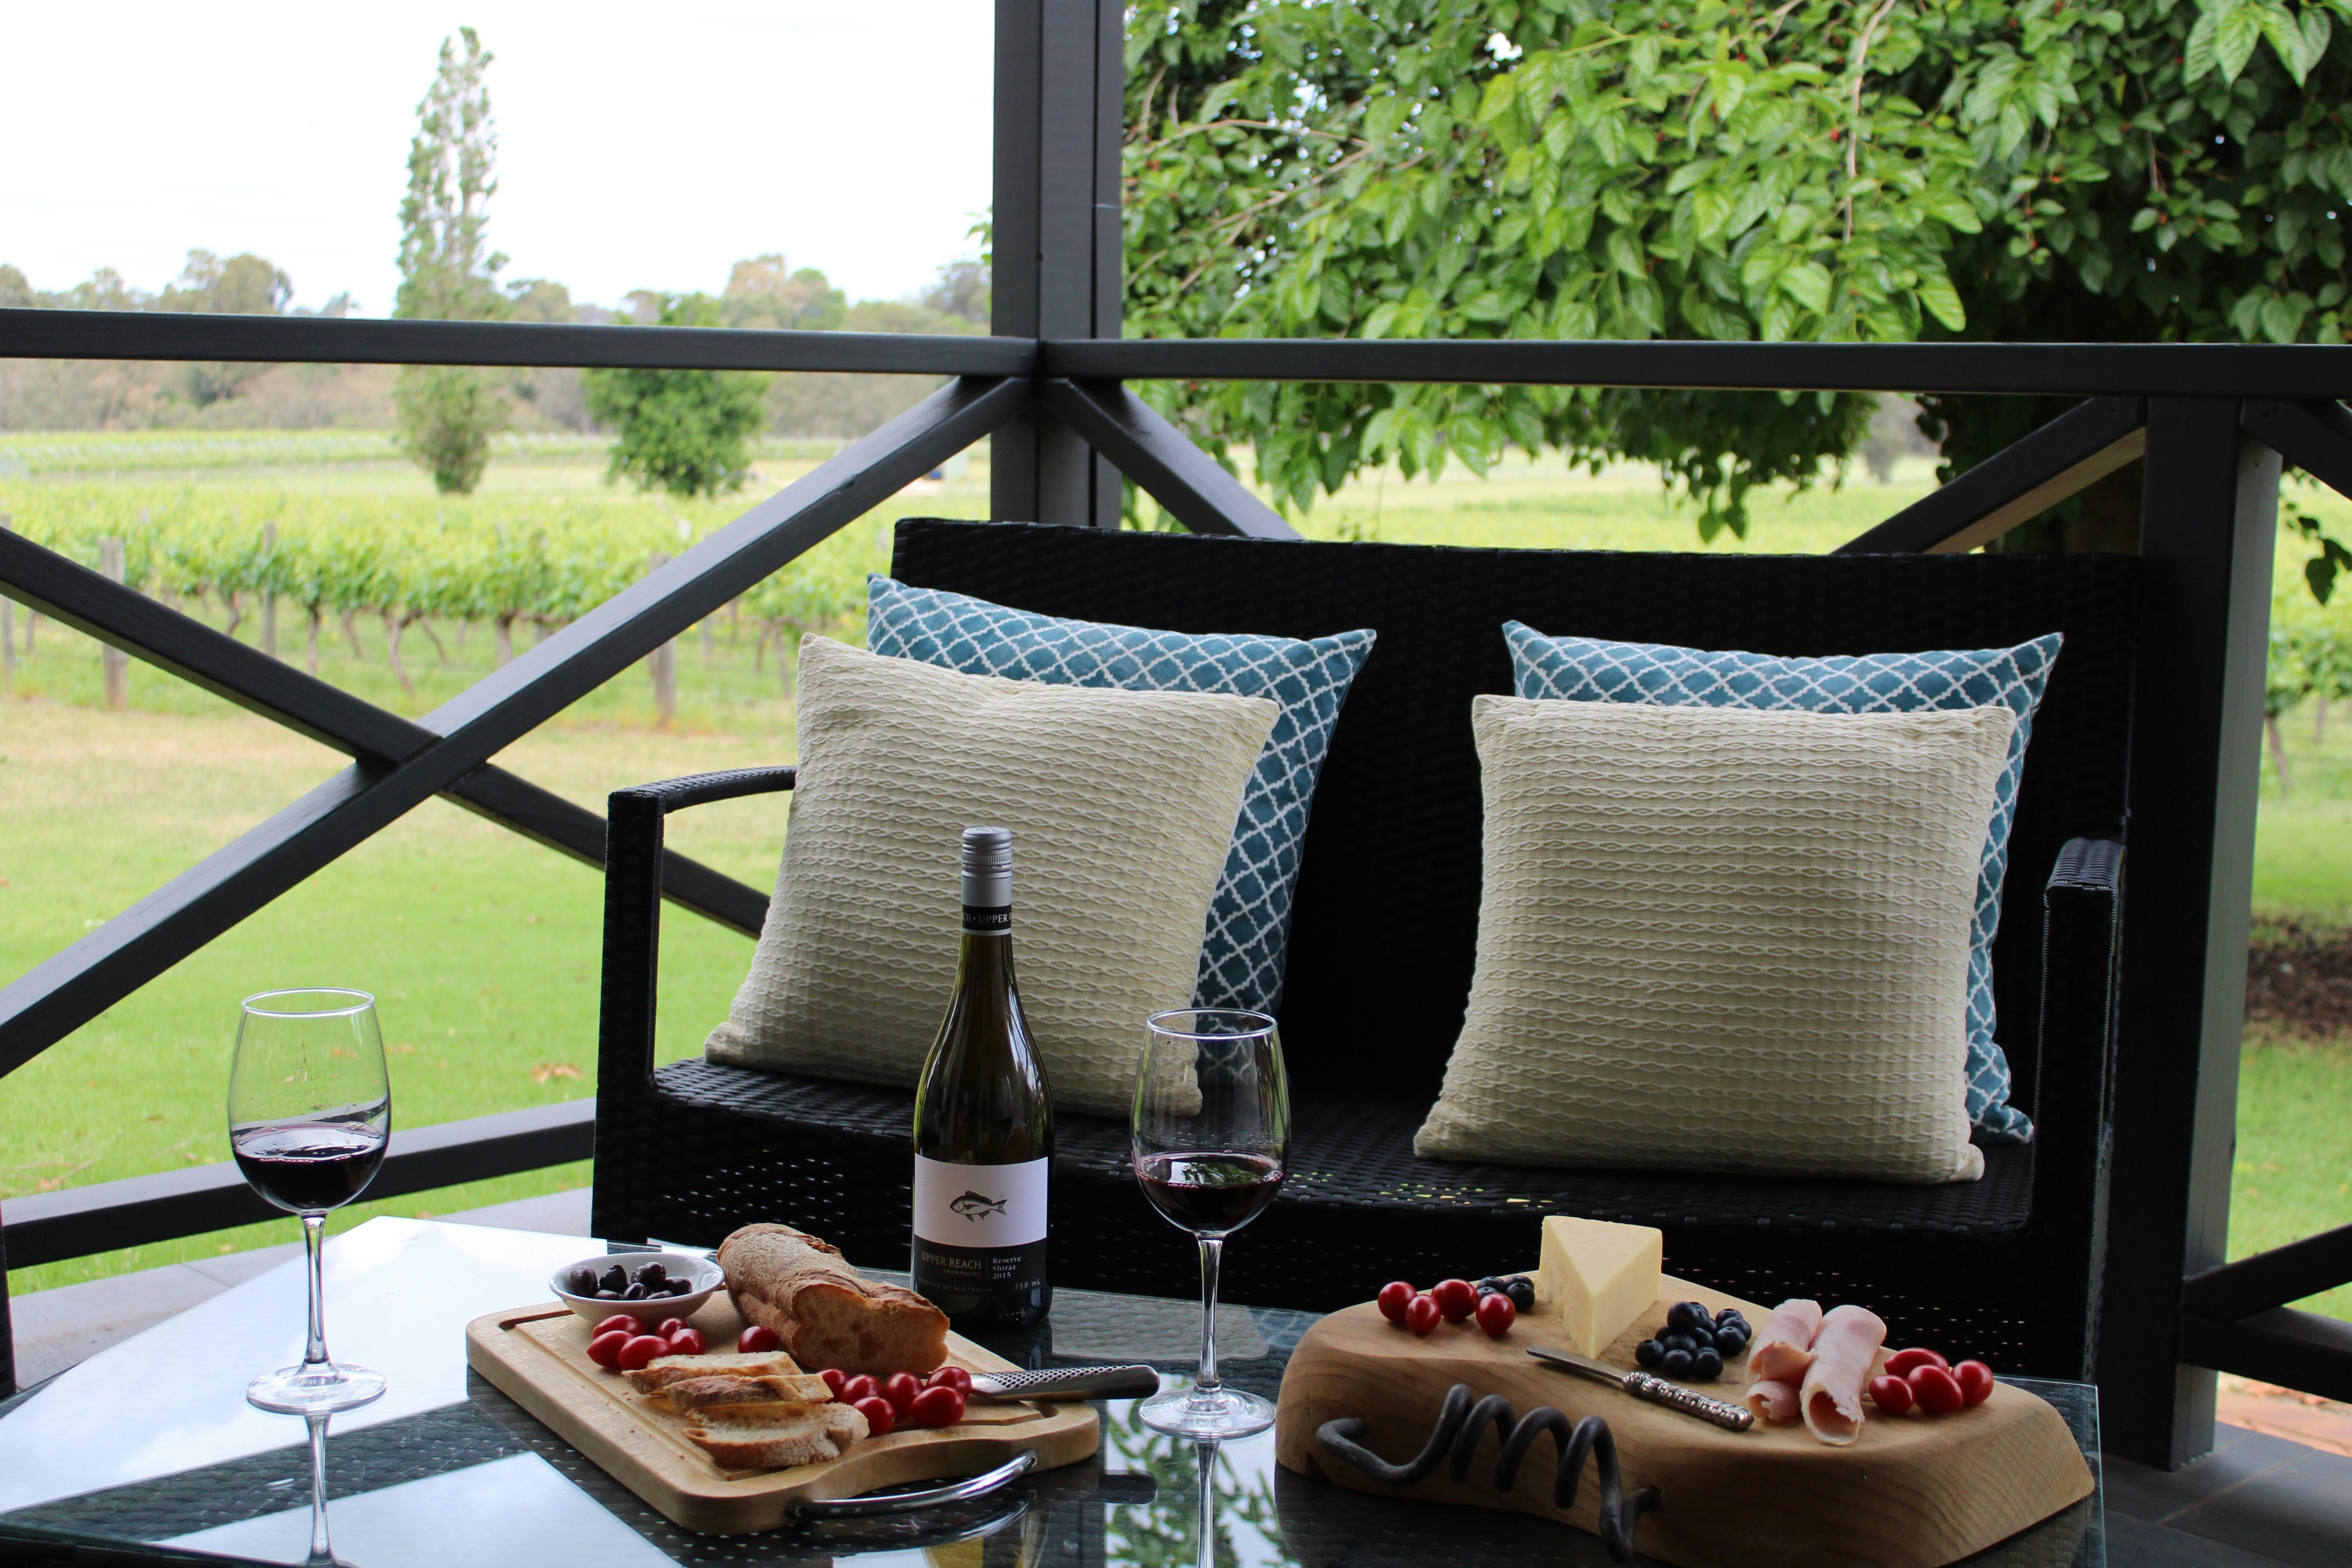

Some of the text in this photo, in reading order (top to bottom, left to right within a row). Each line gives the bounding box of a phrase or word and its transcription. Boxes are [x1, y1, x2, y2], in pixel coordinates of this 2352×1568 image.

[978, 914, 1008, 924] UPPER
[922, 1251, 982, 1269] UPPER REACH
[918, 1277, 940, 1289] PRODUCE
[1015, 1278, 1041, 1290] 750 mL
